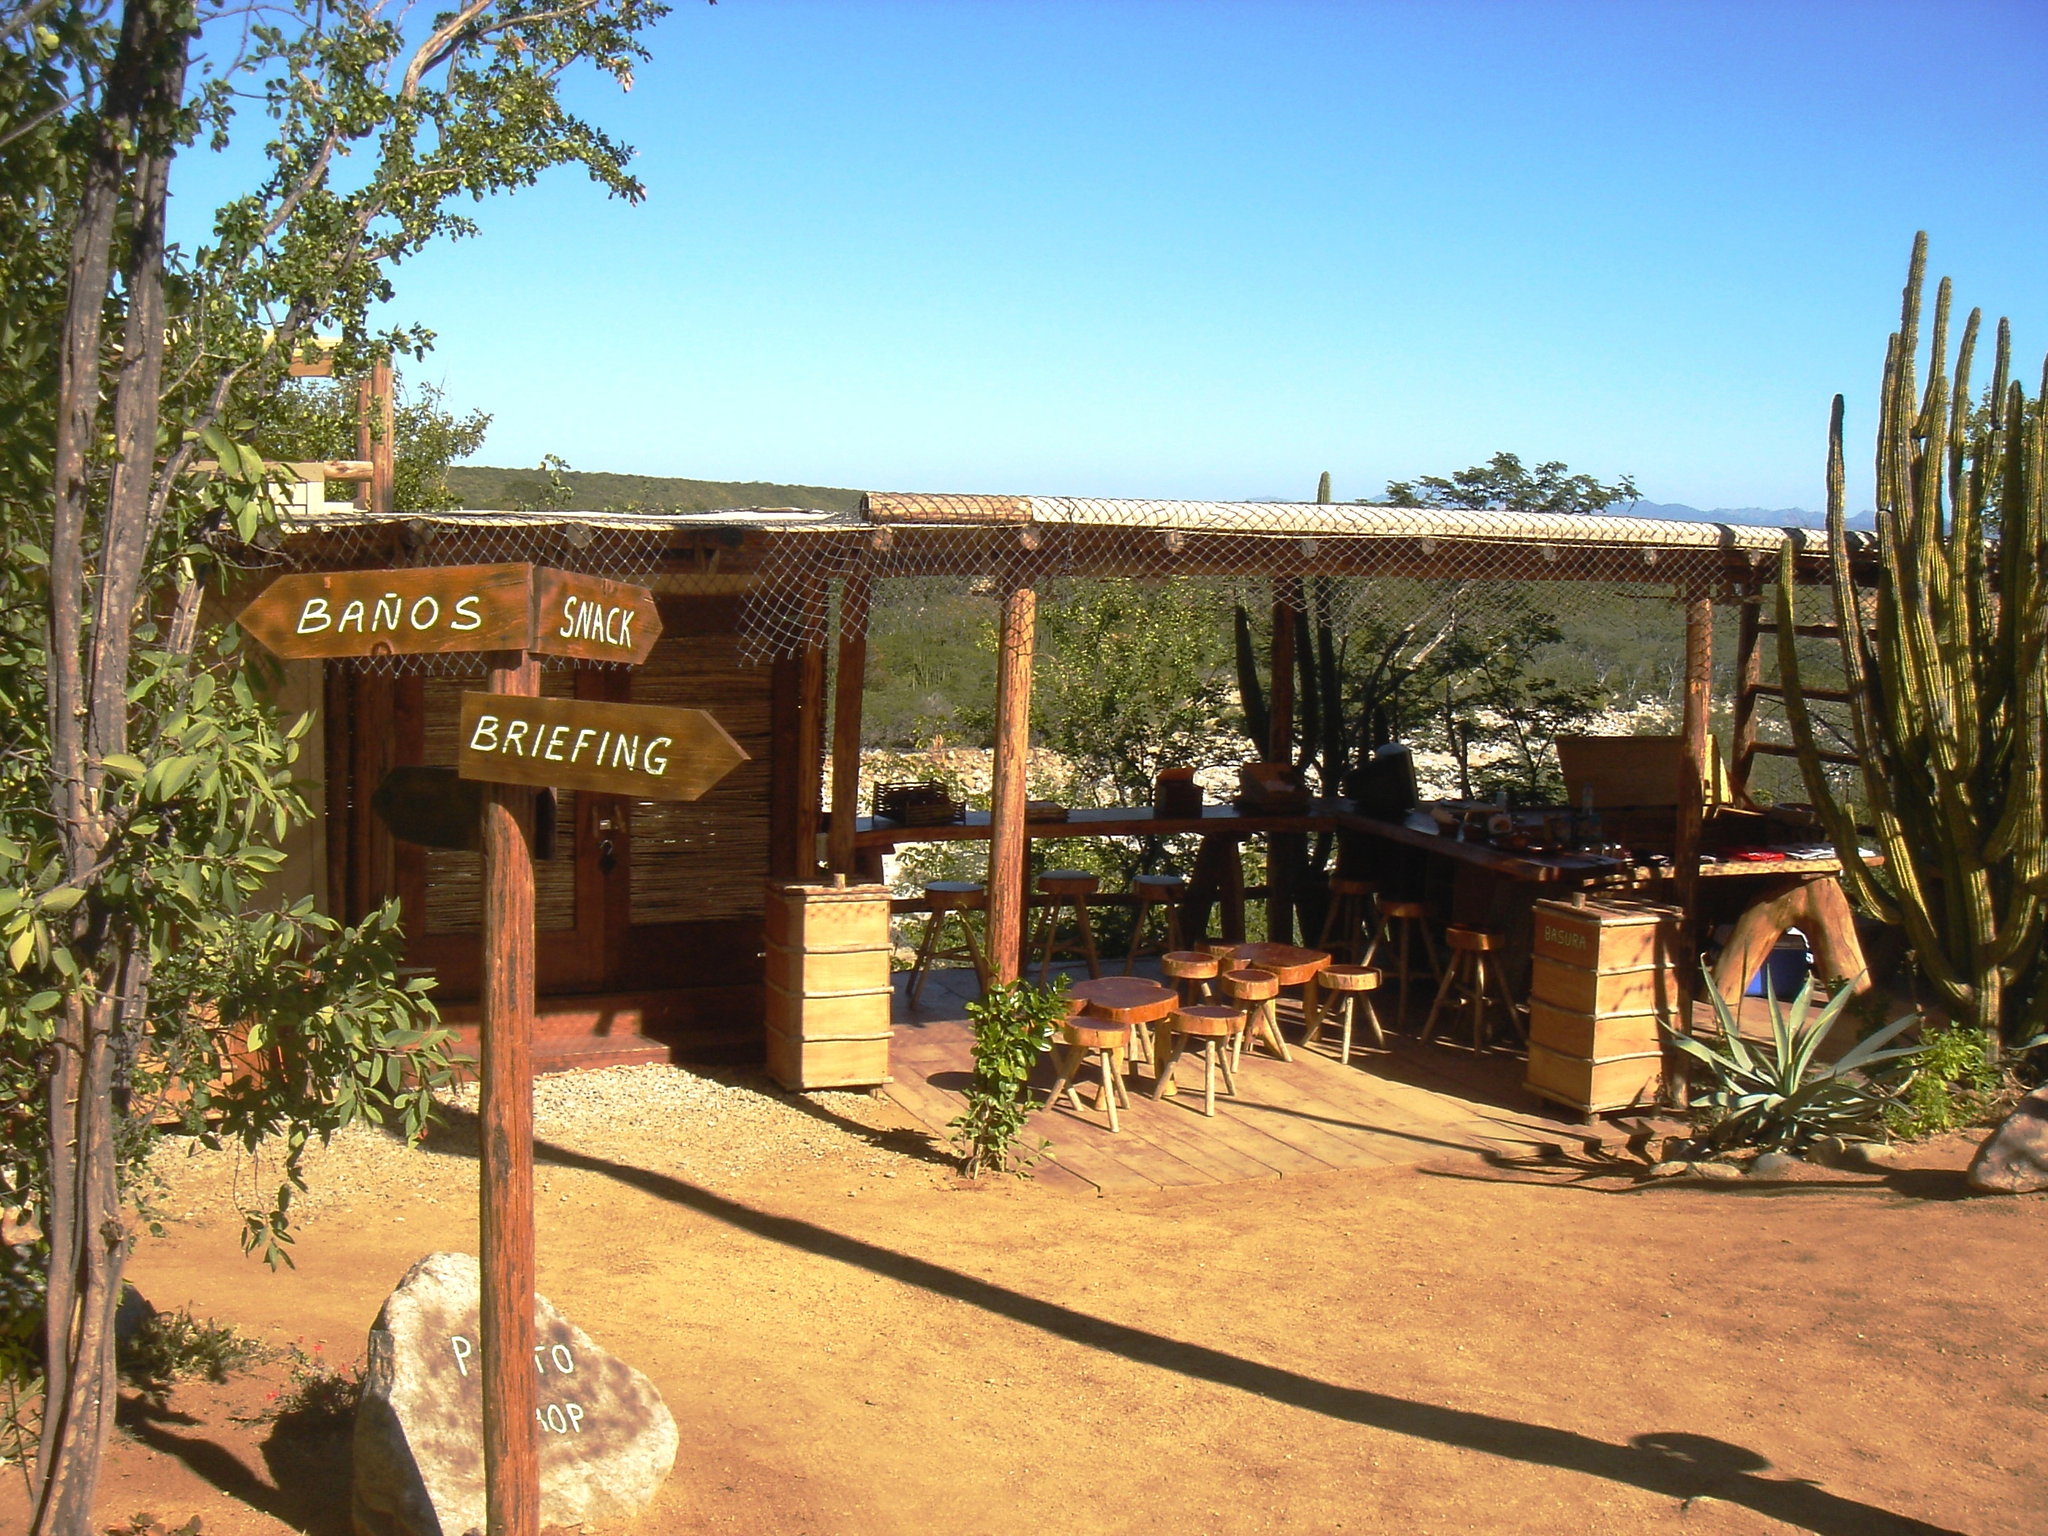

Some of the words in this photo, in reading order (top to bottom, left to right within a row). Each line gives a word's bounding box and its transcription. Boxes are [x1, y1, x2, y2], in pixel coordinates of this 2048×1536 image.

[296, 592, 482, 634] BAÑOS
[559, 594, 635, 648] SNACK
[469, 714, 672, 776] BRIEFING
[1544, 925, 1586, 949] BASURA
[451, 1335, 574, 1376] PTO
[535, 1402, 584, 1434] OP
